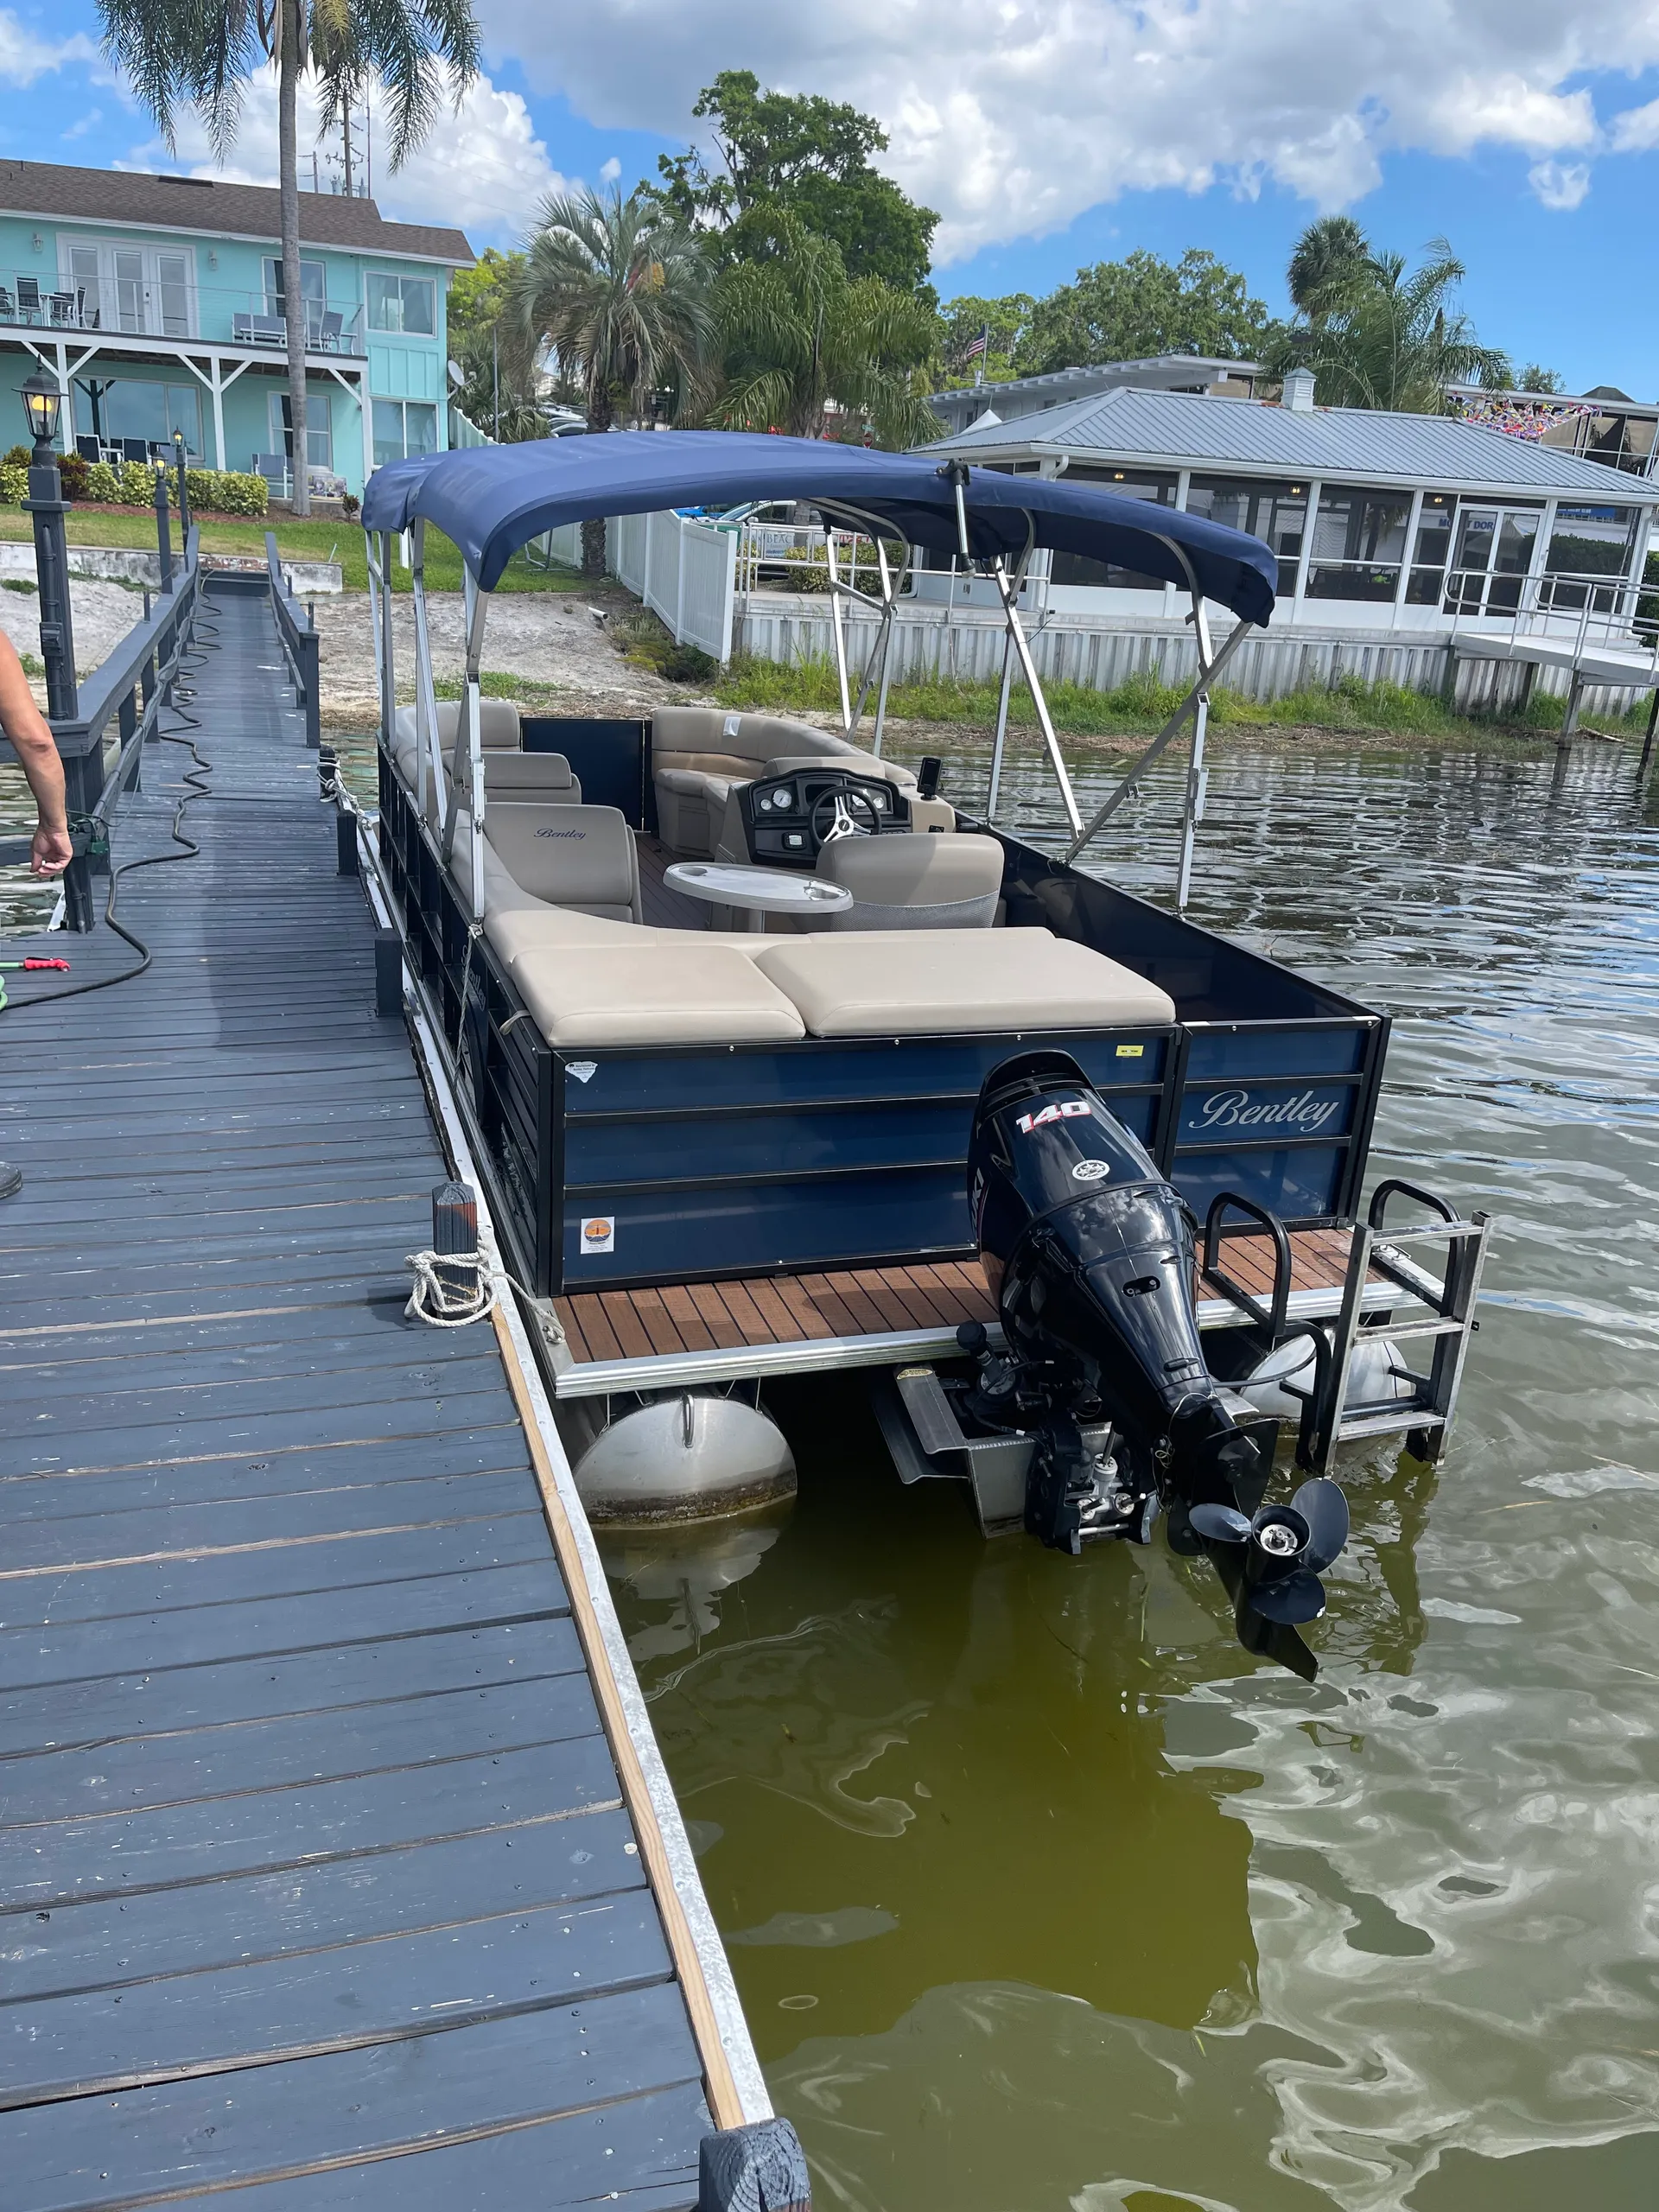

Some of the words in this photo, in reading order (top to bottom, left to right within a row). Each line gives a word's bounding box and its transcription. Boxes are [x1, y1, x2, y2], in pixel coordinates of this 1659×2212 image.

[1474, 521, 1495, 530] DOR
[767, 533, 792, 543] BEAC
[533, 828, 586, 840] Bentley
[1188, 1090, 1339, 1132] Bentley
[1016, 1102, 1091, 1134] 140
